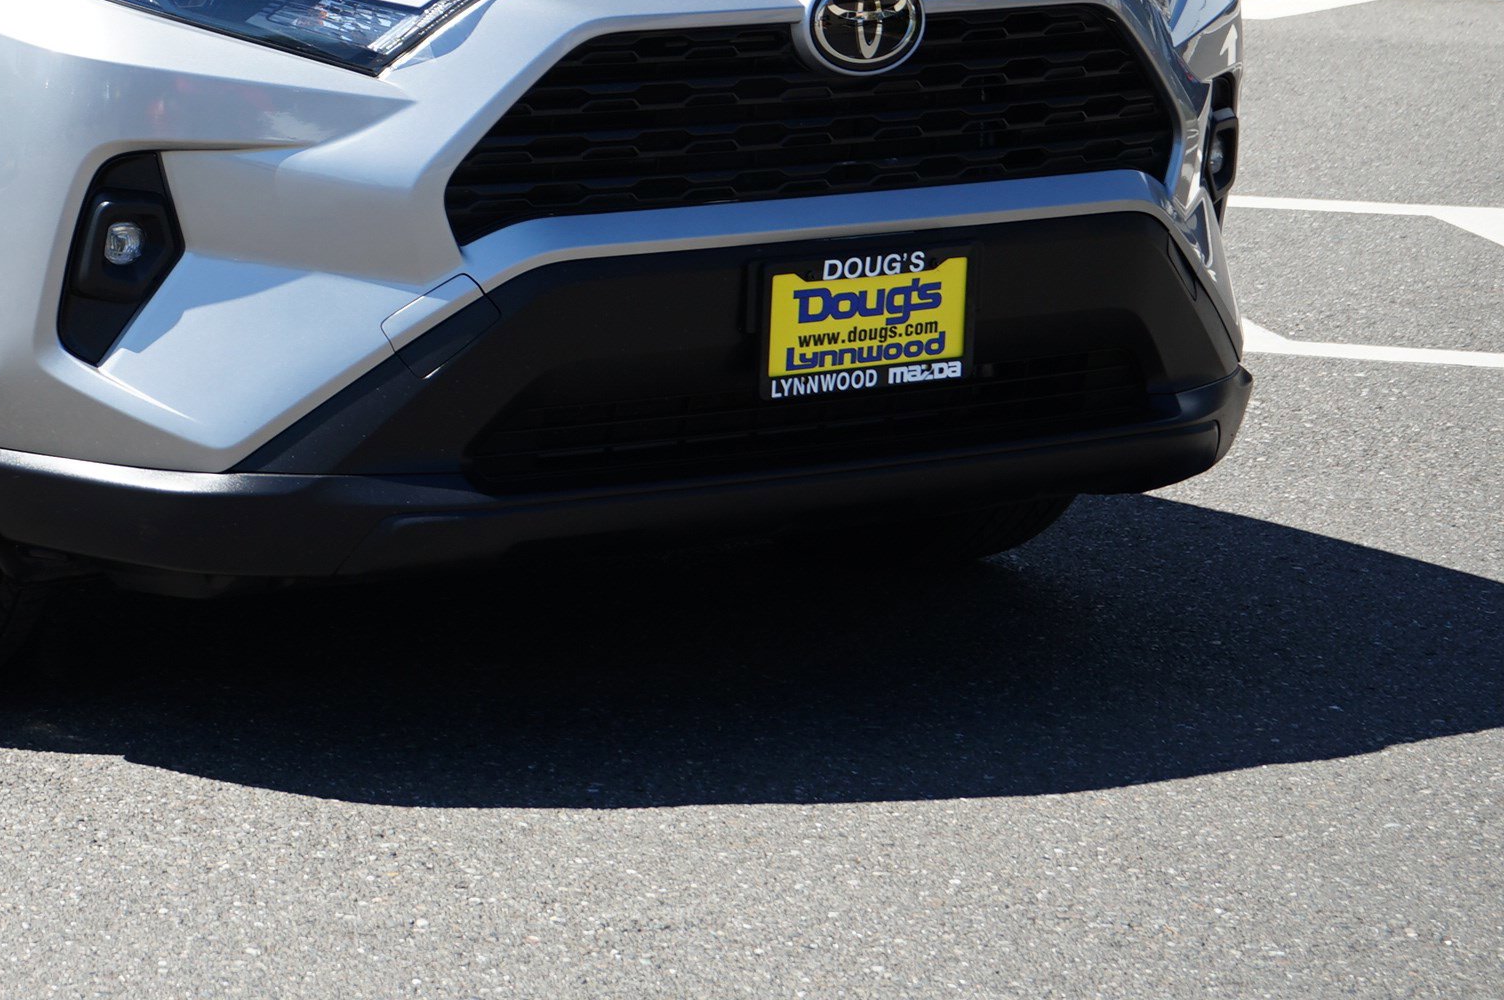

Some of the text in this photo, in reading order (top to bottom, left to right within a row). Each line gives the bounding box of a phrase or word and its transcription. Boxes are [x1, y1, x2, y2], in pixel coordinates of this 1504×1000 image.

[822, 250, 926, 281] DOUG'S
[793, 278, 942, 325] Doug's
[798, 320, 939, 347] www.dougs.com
[785, 331, 946, 371] Lynnwood
[770, 368, 878, 399] LYNNWOOD
